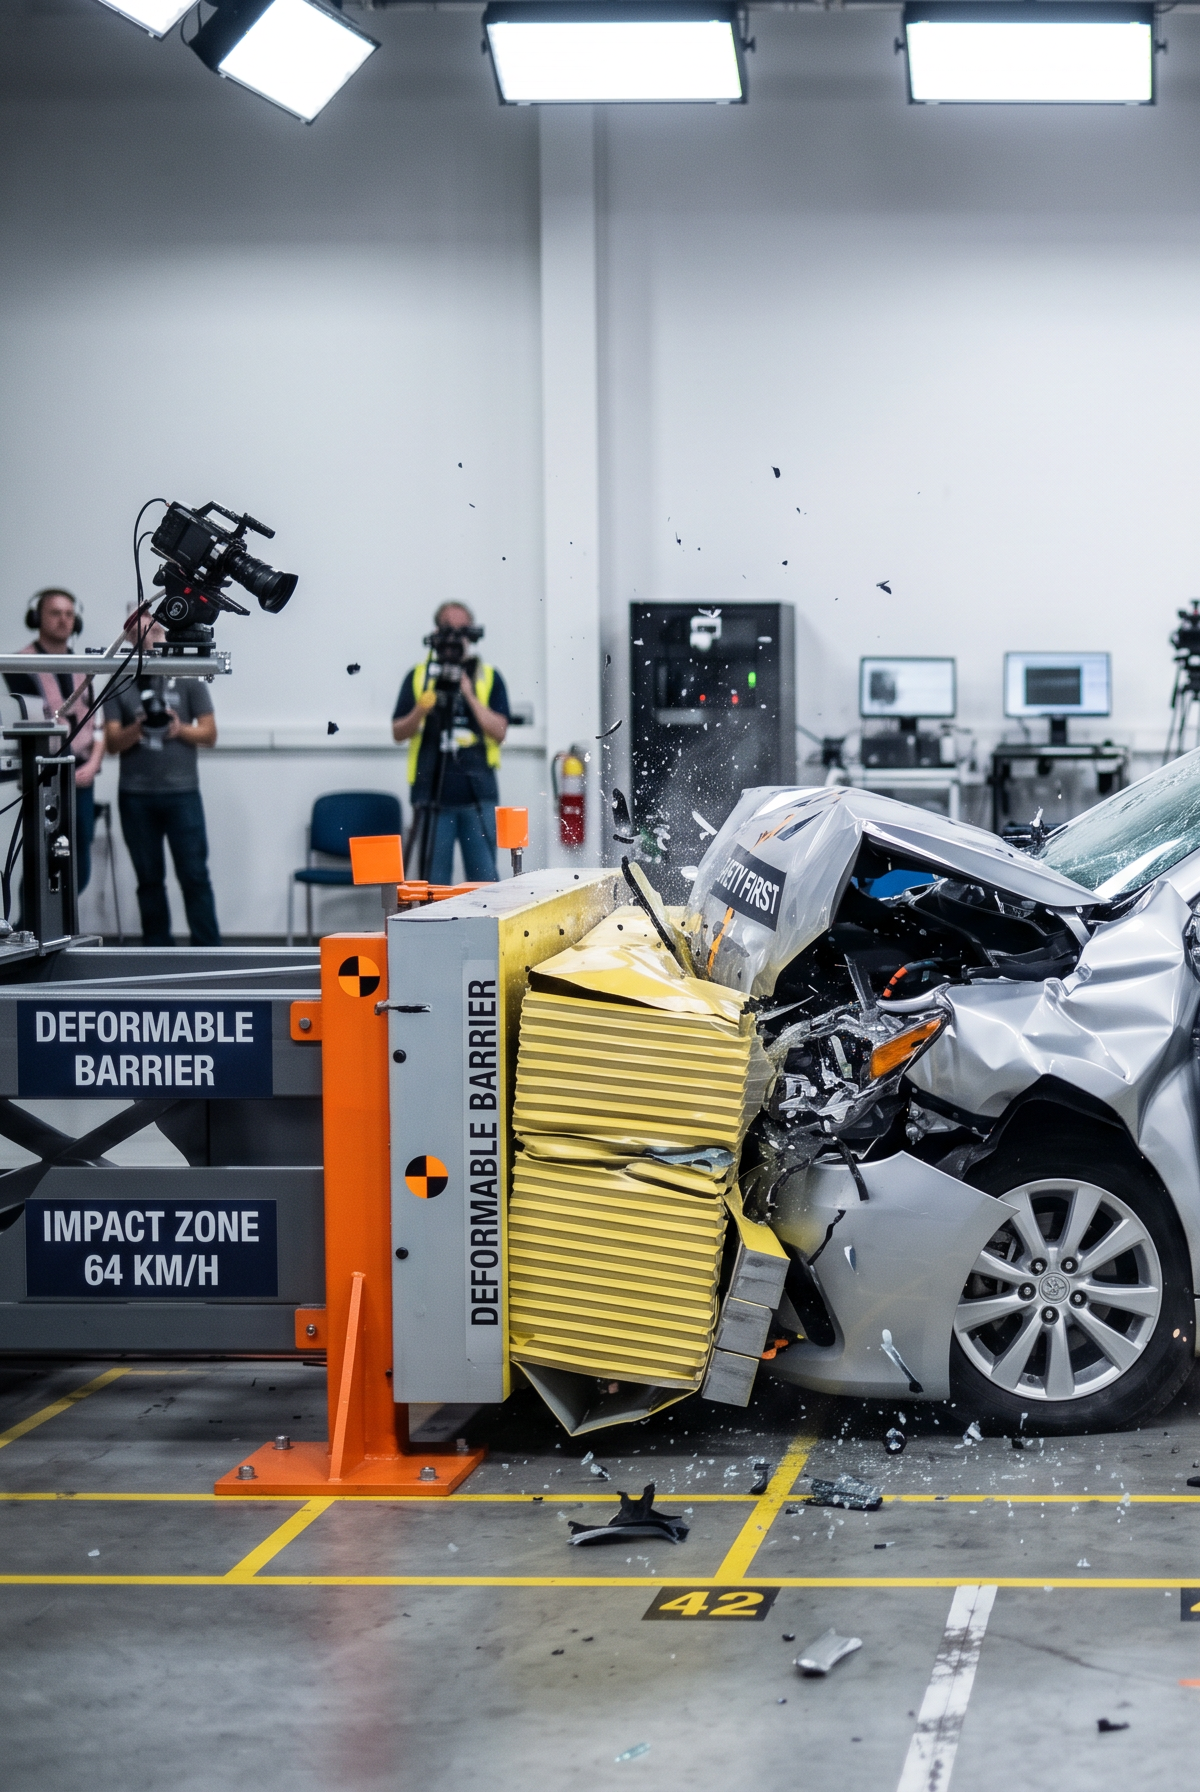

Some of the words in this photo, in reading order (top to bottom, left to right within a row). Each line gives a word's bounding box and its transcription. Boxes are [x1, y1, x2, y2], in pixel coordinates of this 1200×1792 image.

[739, 870, 780, 915] FIRST
[35, 1010, 255, 1044] DEFORMABLE
[468, 979, 497, 1111] BARRIER
[74, 1054, 215, 1087] BARRIER
[43, 1210, 165, 1243] IMPACT
[174, 1210, 260, 1243] ZONE
[469, 1122, 499, 1326] DEFORMABLE
[84, 1254, 123, 1286] 64
[133, 1254, 219, 1288] KM/H
[658, 1591, 765, 1616] 42
